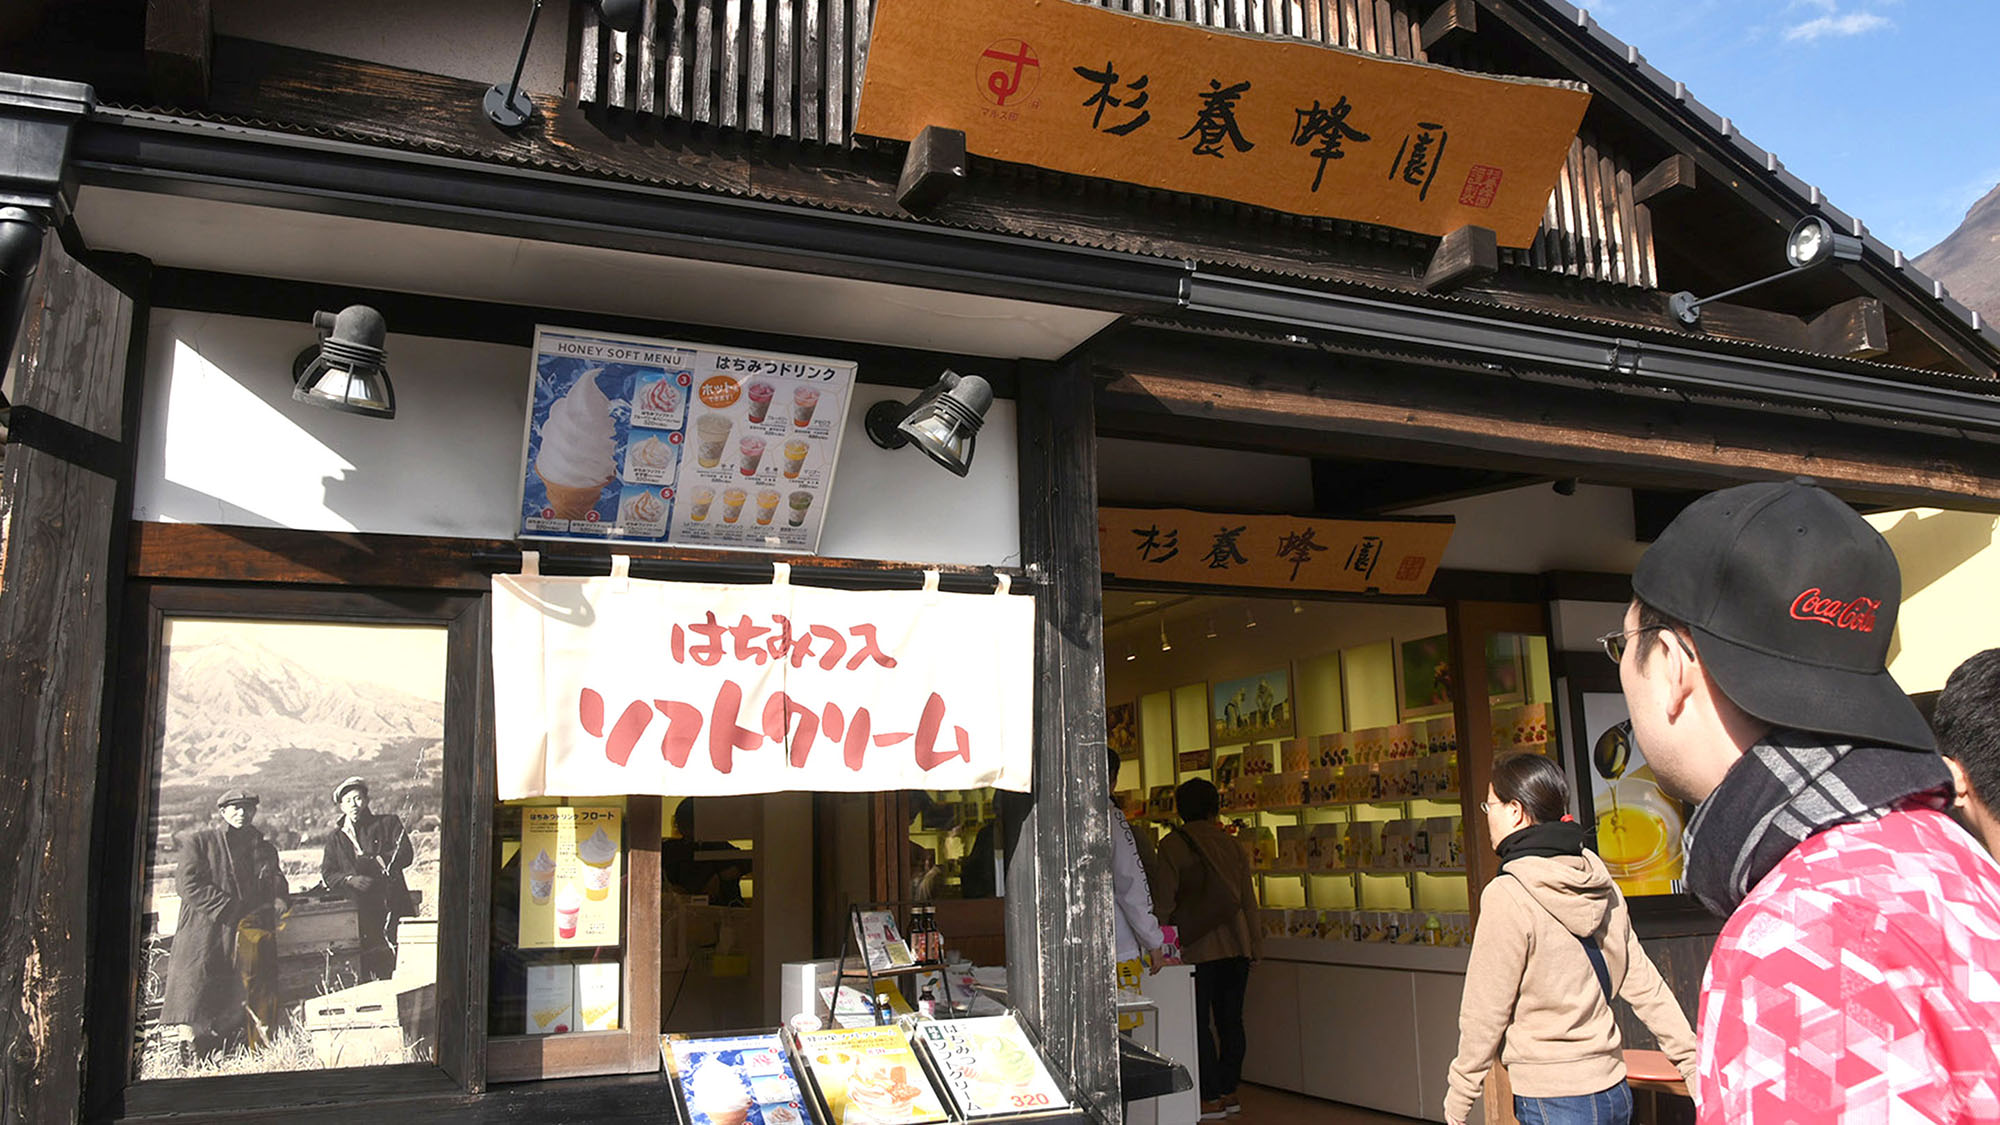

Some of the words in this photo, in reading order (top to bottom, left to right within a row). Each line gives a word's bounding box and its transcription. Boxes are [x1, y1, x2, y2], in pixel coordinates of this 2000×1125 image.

[1073, 60, 1448, 202] 杉養蜂園
[557, 341, 604, 357] HONEY
[606, 347, 641, 361] SOFT
[643, 351, 682, 366] MENU
[716, 355, 836, 381] はちみつドリンク
[1131, 524, 1384, 582] 杉養蜂園
[670, 610, 898, 671] はちみつ入
[579, 679, 971, 774] ソフトクリーム
[581, 811, 615, 820] フロート
[943, 1024, 976, 1065] はちみつ
[932, 1040, 983, 1112] ソフトクリーム
[1010, 1092, 1050, 1108] 320
